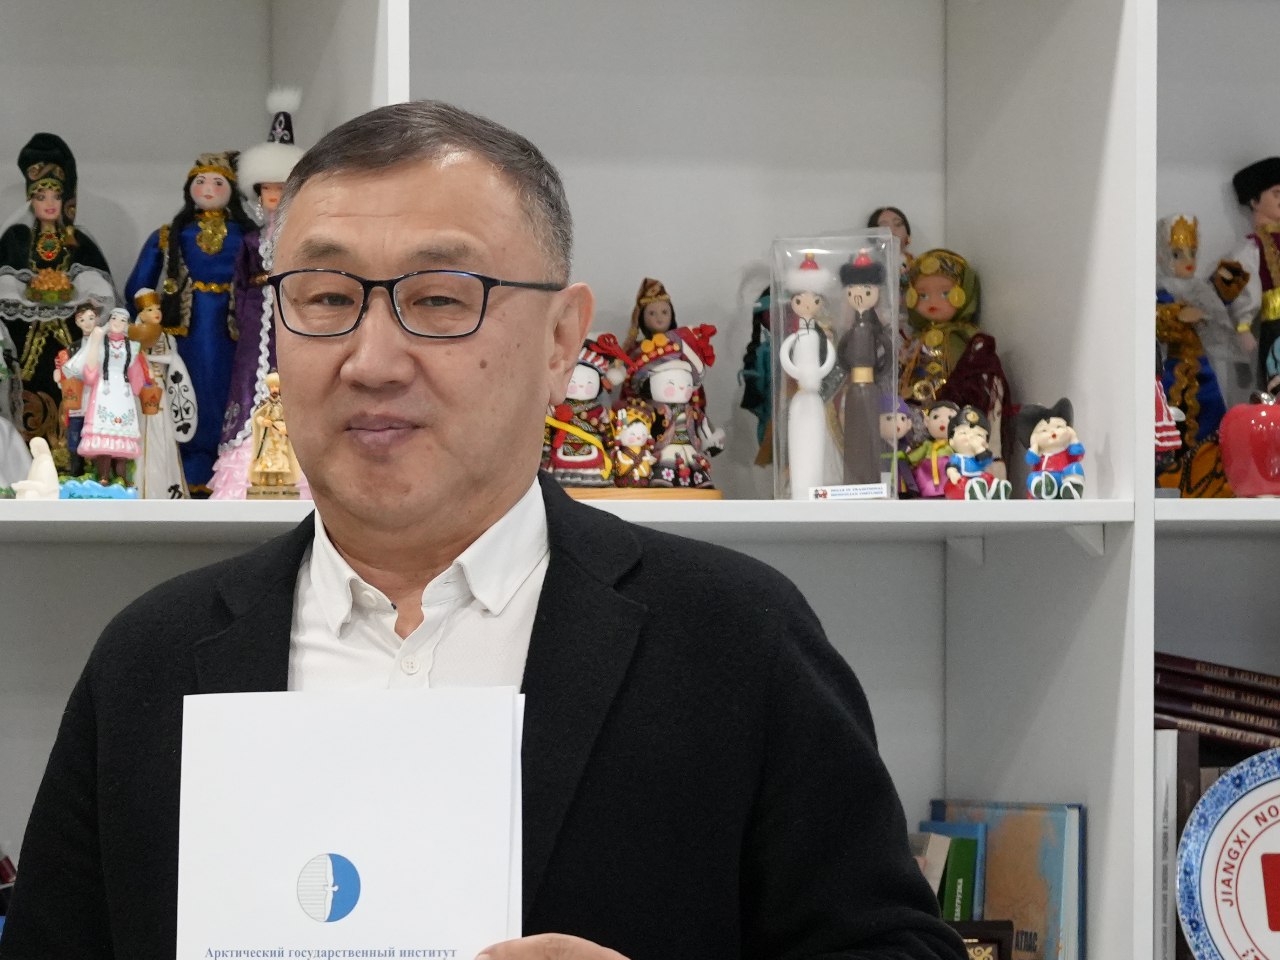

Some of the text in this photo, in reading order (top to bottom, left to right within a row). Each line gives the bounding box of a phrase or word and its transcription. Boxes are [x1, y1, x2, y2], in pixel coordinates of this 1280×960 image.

[1221, 828, 1250, 907] JIANGXI
[204, 947, 458, 960] Арктический государственный институт
